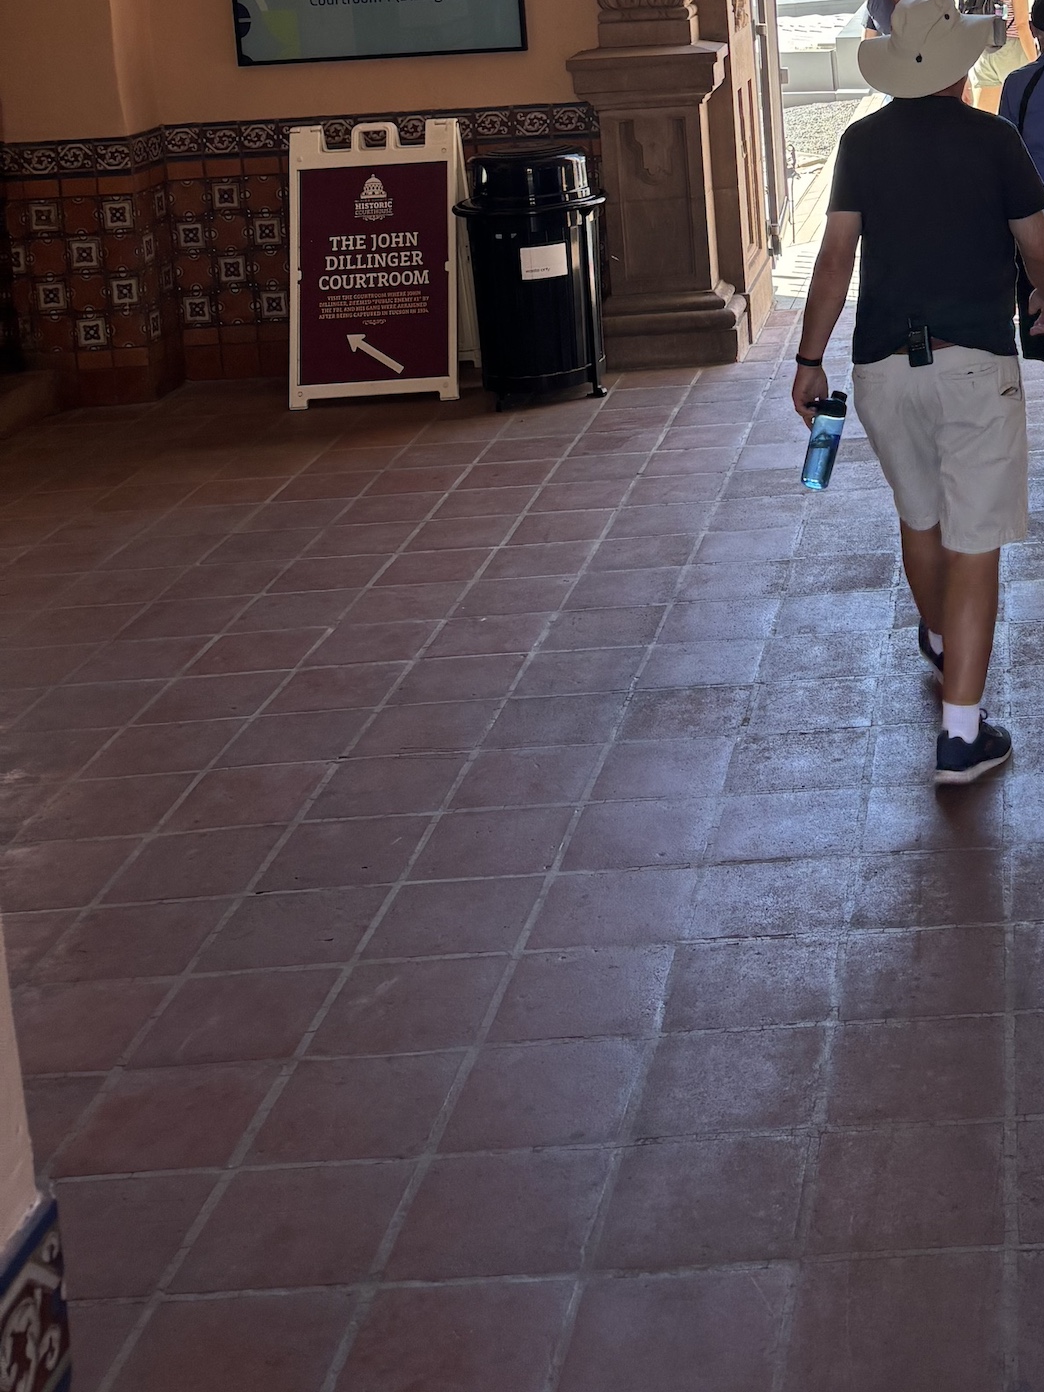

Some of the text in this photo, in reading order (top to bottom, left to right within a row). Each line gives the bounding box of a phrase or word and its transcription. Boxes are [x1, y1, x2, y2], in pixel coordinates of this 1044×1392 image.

[354, 201, 393, 210] HISTORIC
[329, 231, 419, 251] THE JOHN
[325, 250, 424, 271] DILLINGER
[318, 269, 430, 291] COURTROOM
